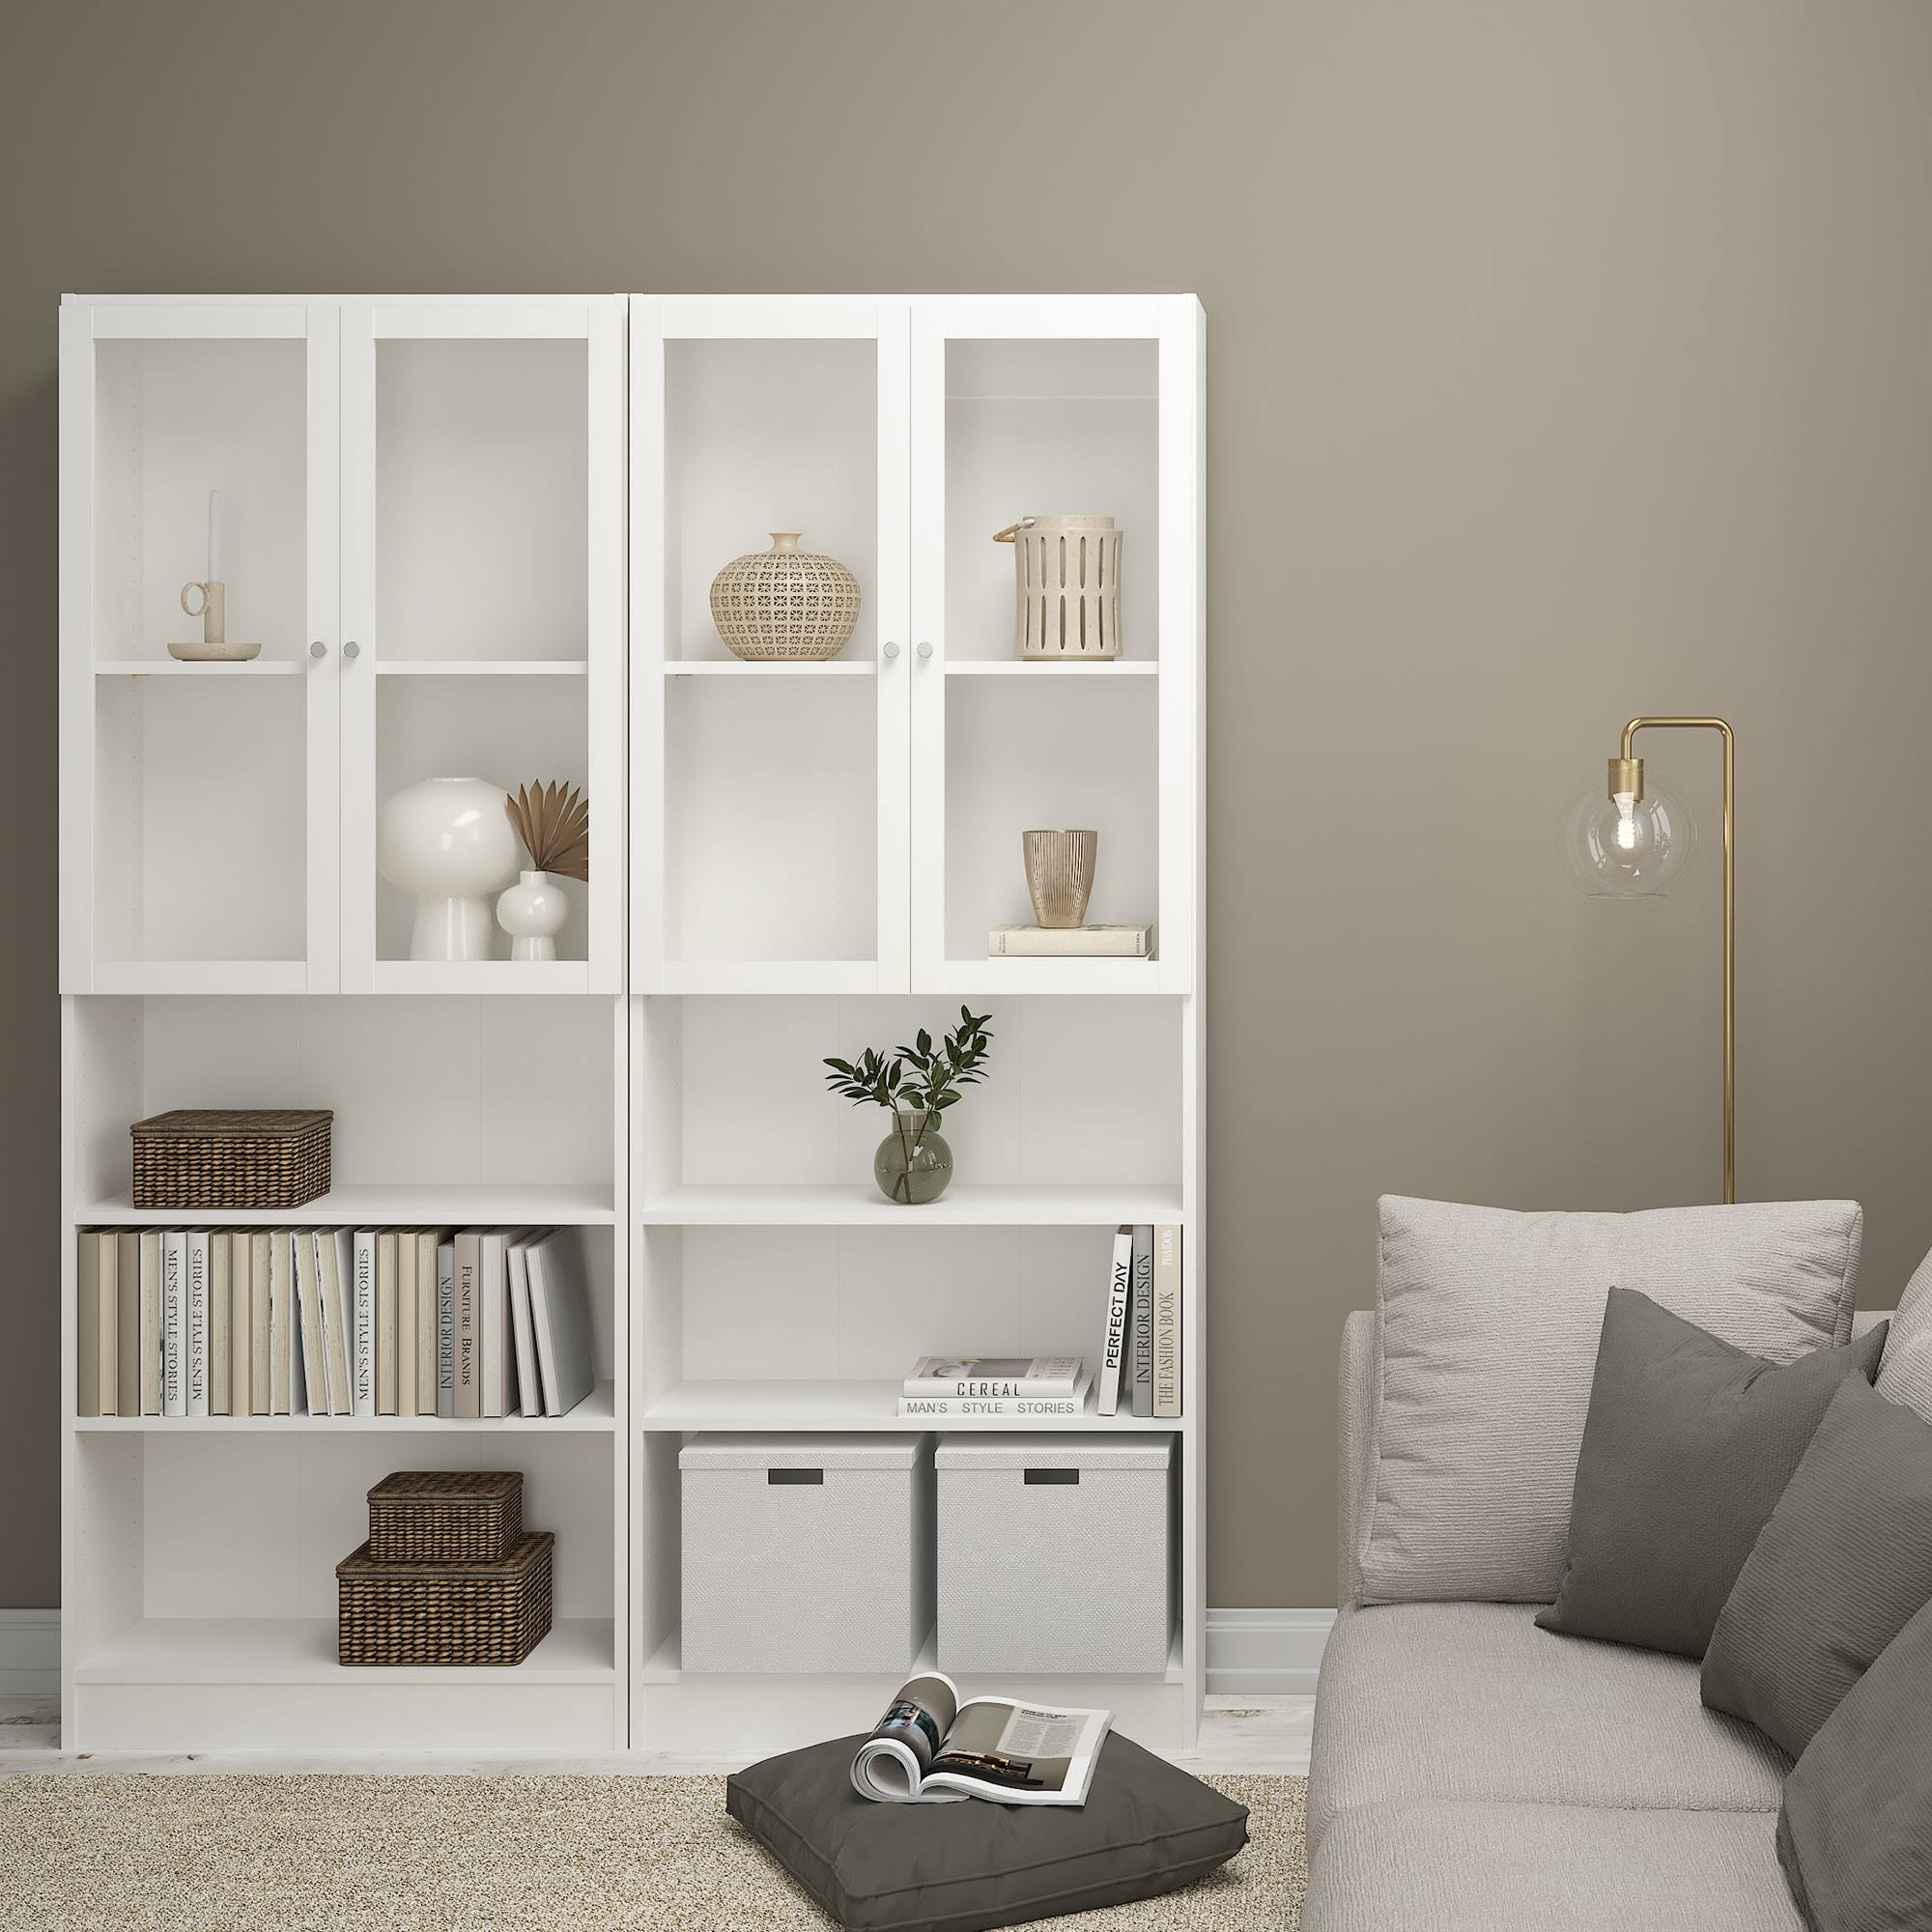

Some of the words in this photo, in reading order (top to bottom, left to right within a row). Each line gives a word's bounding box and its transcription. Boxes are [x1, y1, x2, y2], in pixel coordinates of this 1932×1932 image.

[167, 1249, 179, 1293] MEN'S
[191, 1248, 203, 1307] STORIES
[358, 1248, 369, 1307] STORIES
[1114, 1262, 1128, 1293] DAY
[1136, 1254, 1151, 1309] DESIGN
[167, 1295, 179, 1340] STYLE
[440, 1276, 452, 1324] DESIGN
[462, 1265, 472, 1331] FURNITURE
[1158, 1293, 1174, 1324] BOOK
[191, 1310, 203, 1354] STYLE
[358, 1310, 369, 1354] STYLE
[1105, 1295, 1125, 1369] PERFECT
[1136, 1315, 1151, 1383] INTERIOR
[1158, 1328, 1174, 1379] FASHION
[167, 1342, 179, 1401] STORIES
[191, 1358, 203, 1401] MEN'S
[358, 1358, 369, 1401] MEN'S
[440, 1328, 452, 1389] INTERIOR
[462, 1338, 472, 1385] BRANDS
[906, 1402, 948, 1414] MAN'S
[961, 1402, 1004, 1414] STYLE
[1017, 1402, 1074, 1414] STORIES
[956, 1382, 1021, 1397] CEREAL
[1158, 1383, 1174, 1406] THE
